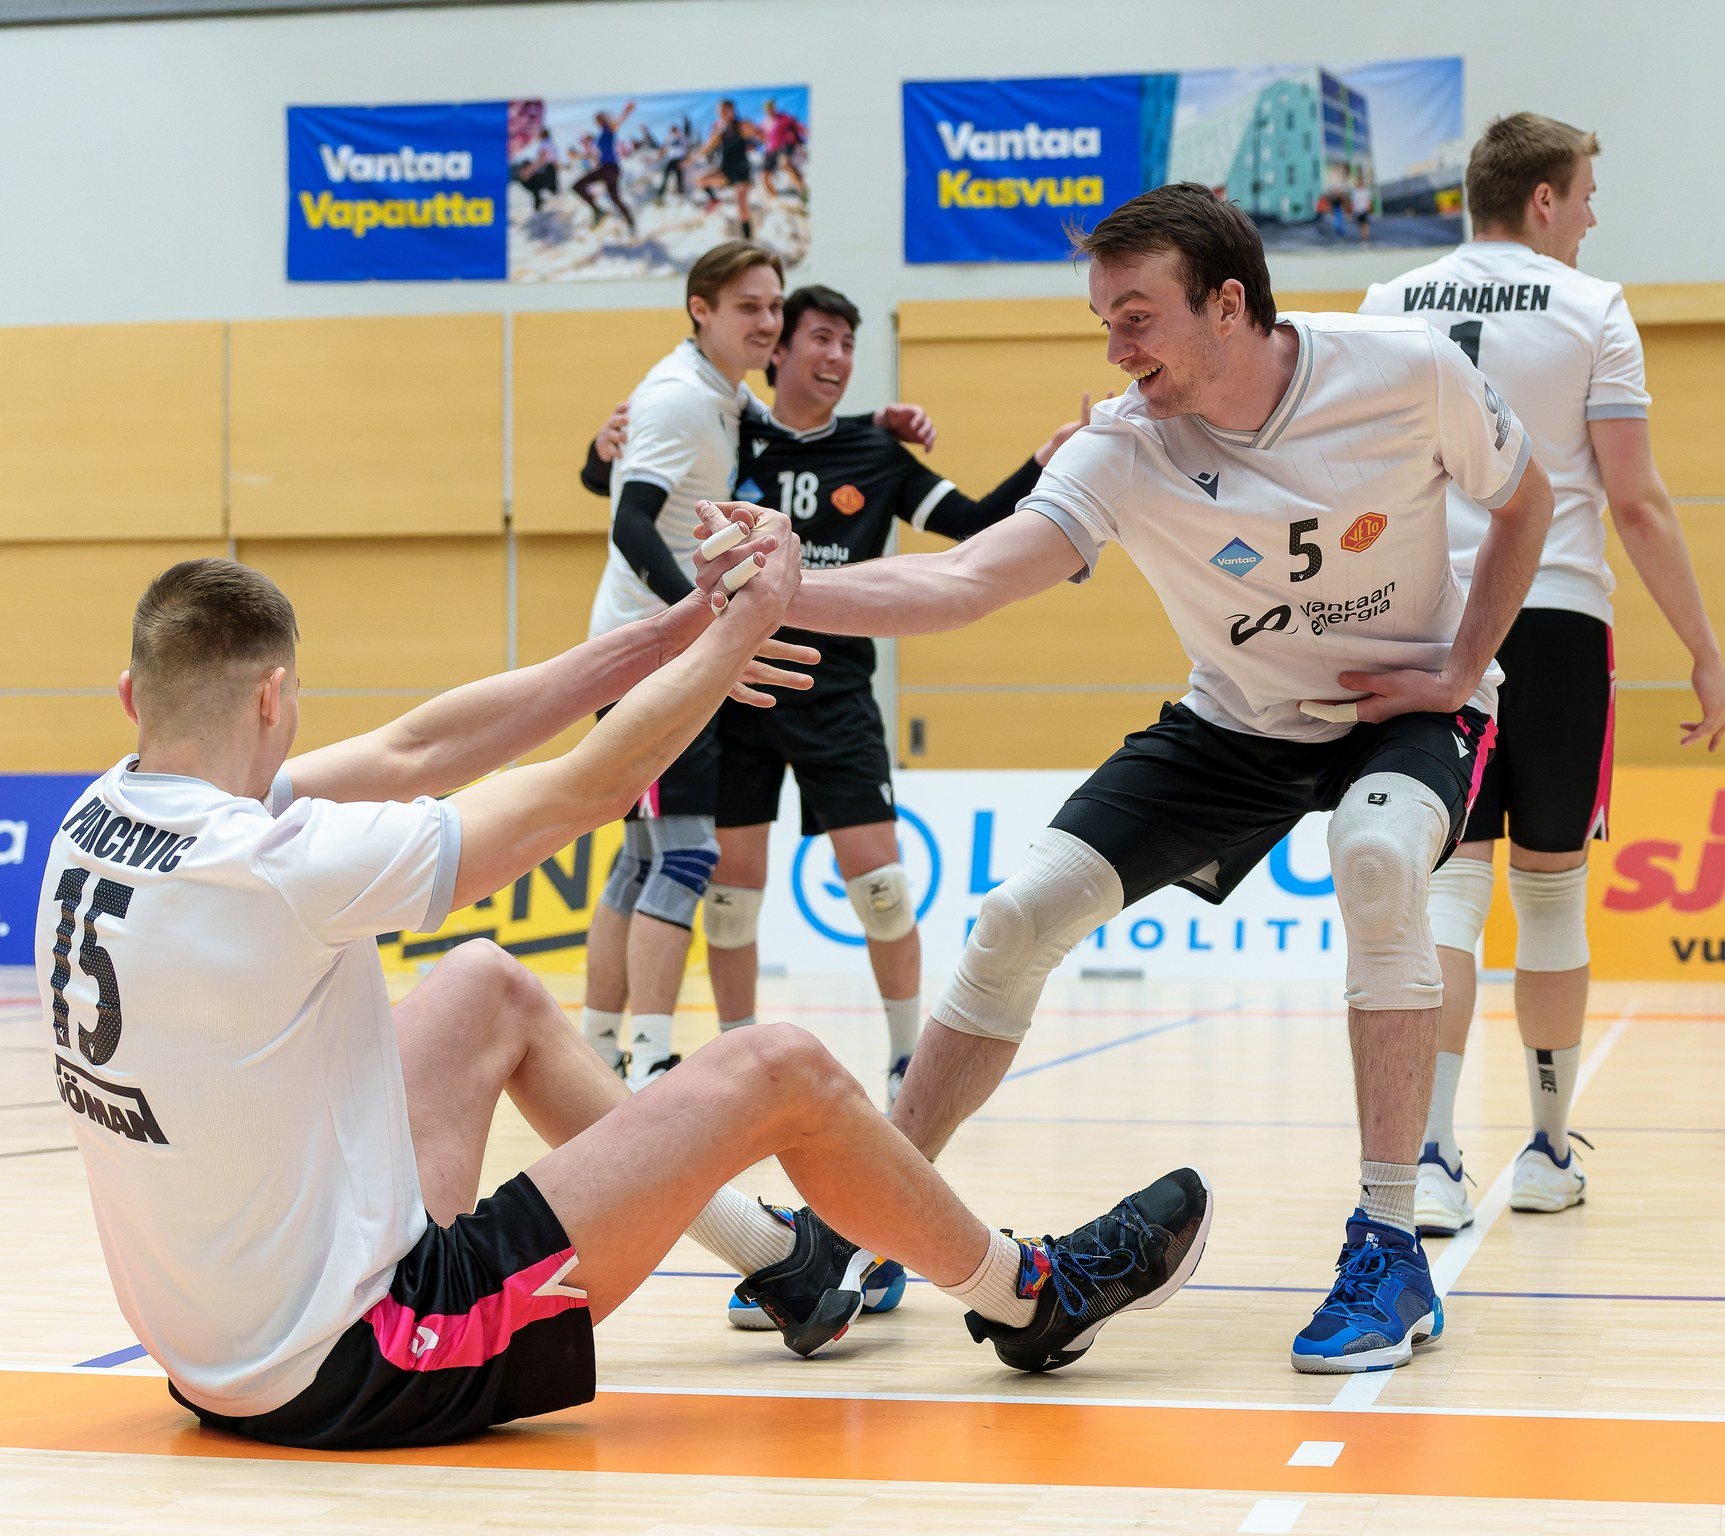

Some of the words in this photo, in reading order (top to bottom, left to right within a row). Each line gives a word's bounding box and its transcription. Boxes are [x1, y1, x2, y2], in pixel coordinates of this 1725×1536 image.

[939, 120, 1102, 161] Vantaa
[319, 143, 473, 184] Vantaa
[937, 168, 1105, 209] Kasvua
[299, 190, 496, 239] Vapautta
[1403, 281, 1551, 314] VÄÄNÄNEN
[777, 470, 819, 520] 18
[1217, 555, 1257, 567] Vantaa
[1288, 517, 1323, 583] 5
[1310, 599, 1391, 636] energia
[50, 867, 135, 1066] 15
